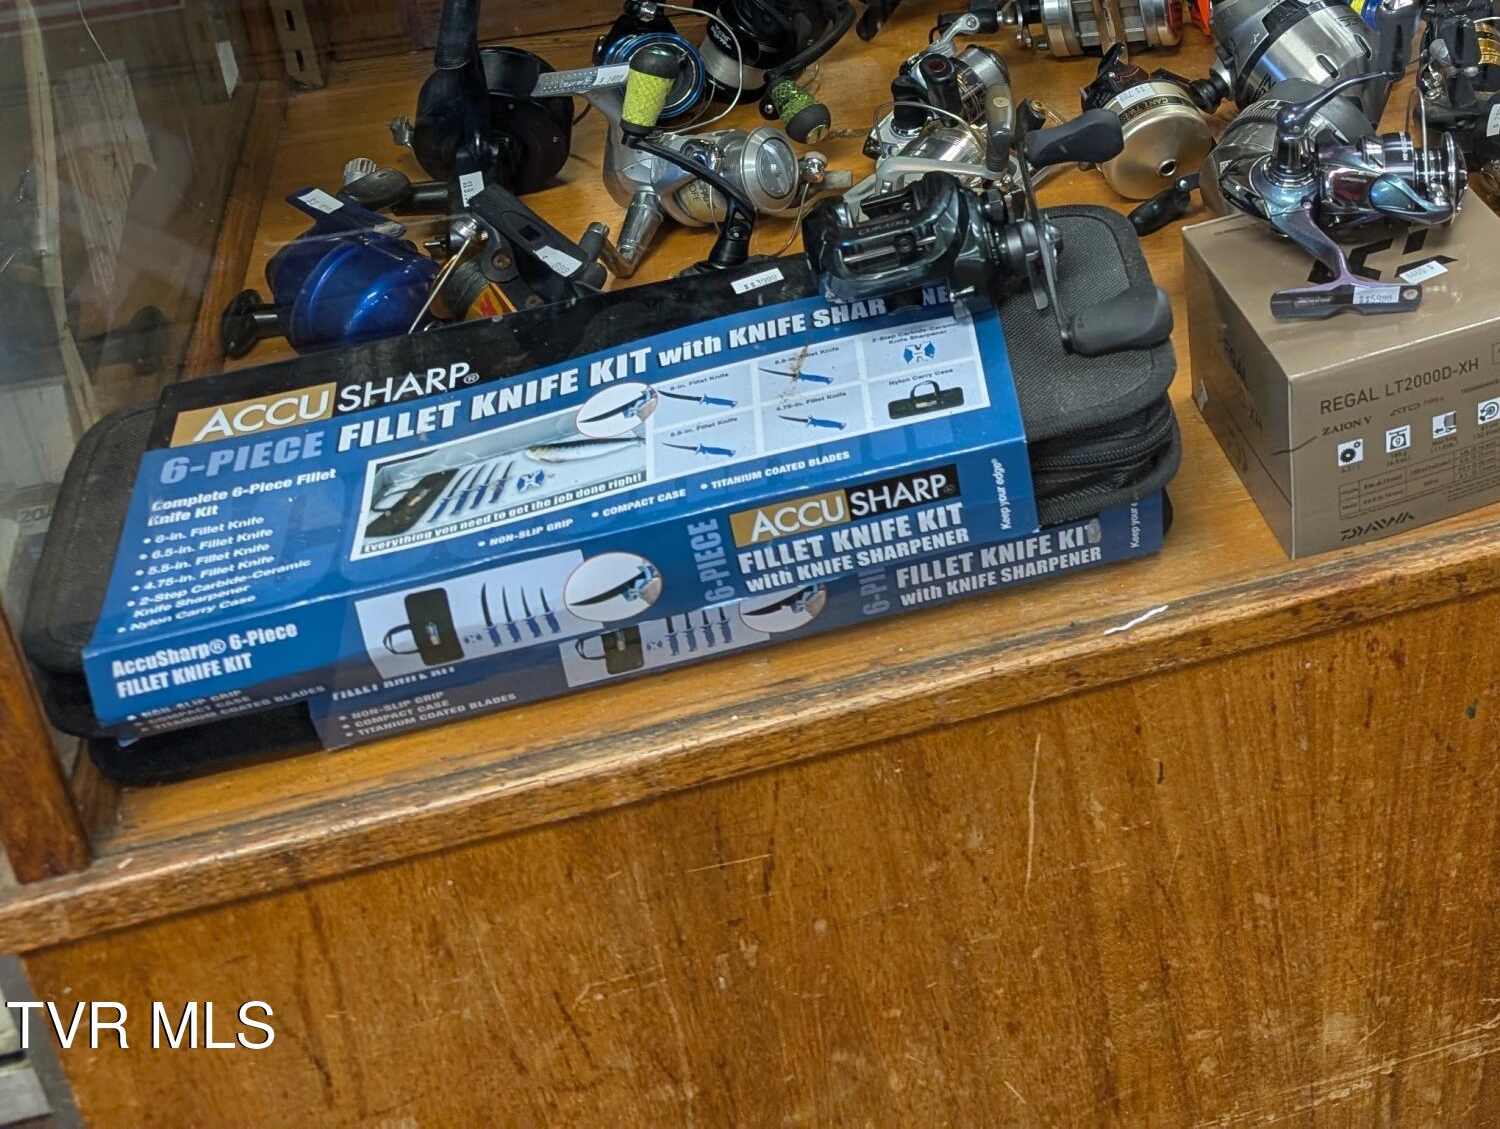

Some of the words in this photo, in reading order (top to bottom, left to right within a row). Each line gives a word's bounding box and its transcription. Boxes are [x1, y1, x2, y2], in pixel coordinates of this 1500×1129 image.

[160, 430, 325, 485] 6-PIECE
[338, 400, 462, 453] FILLET
[470, 367, 579, 422] KNIFE
[590, 347, 653, 387] KIT
[660, 332, 722, 367] with
[729, 312, 807, 349] KNIFE
[193, 390, 332, 444] ACCU
[1320, 386, 1379, 415] REGAL
[1384, 357, 1479, 397] LT2000D-XH
[146, 508, 192, 527] Knife
[194, 503, 219, 518] Kit
[151, 489, 229, 513] Complete
[231, 477, 294, 498] 6-Piece
[296, 466, 338, 486] Fillet
[363, 530, 433, 553] Everything
[434, 523, 459, 537] you
[459, 514, 491, 530] need
[494, 511, 506, 520] to
[508, 504, 530, 519] get
[532, 500, 551, 511] the
[555, 491, 575, 506] job
[576, 483, 608, 499] done
[608, 473, 642, 494] right!
[489, 526, 544, 547] NON-SLIP
[546, 518, 574, 532] GRIP
[602, 495, 654, 517] COMPACT
[657, 487, 687, 503] CASE
[710, 471, 762, 490] TITANIUM
[764, 460, 805, 479] COATED
[808, 450, 851, 470] BLADES
[996, 484, 1008, 508] your
[999, 507, 1012, 531] Keep
[688, 517, 735, 604] 6-PIECE
[736, 536, 824, 575] FILLET
[831, 516, 914, 555] KNIFE
[918, 502, 963, 532] KIT
[745, 569, 794, 593] with
[797, 555, 854, 581] KNIFE
[856, 528, 970, 568] SHARPENER
[895, 551, 973, 590] FILLET
[980, 534, 1051, 569] KNIFE
[1057, 521, 1099, 550] KIT
[899, 586, 944, 609] with
[947, 573, 998, 599] KNIFE
[1000, 547, 1102, 587] SHARPENER
[116, 674, 170, 700] FILLET
[172, 662, 222, 689] KNIFE
[223, 652, 253, 674] KIT
